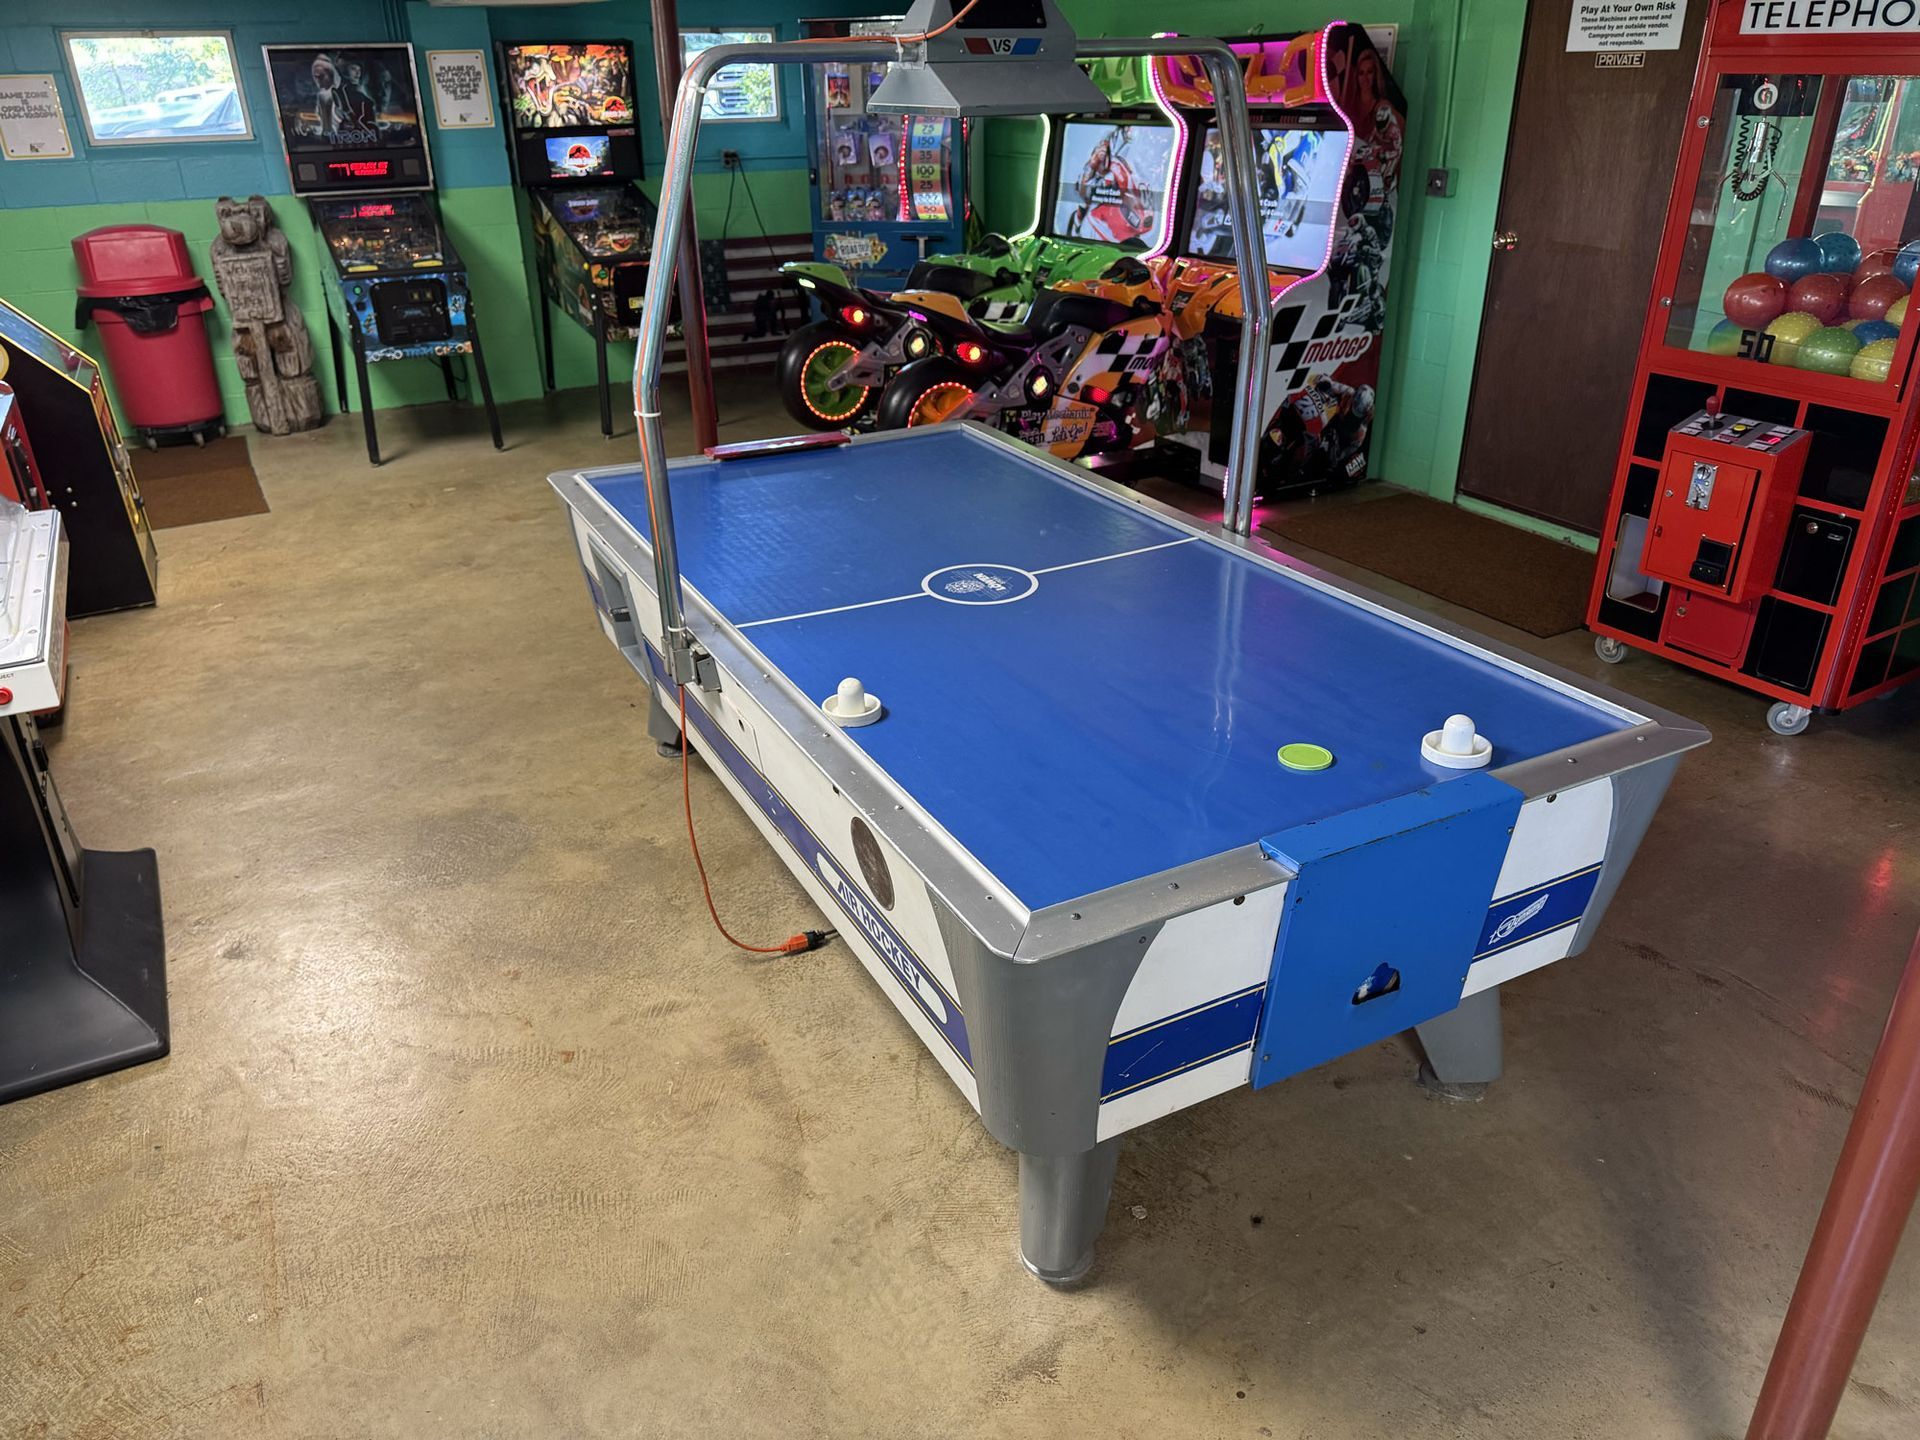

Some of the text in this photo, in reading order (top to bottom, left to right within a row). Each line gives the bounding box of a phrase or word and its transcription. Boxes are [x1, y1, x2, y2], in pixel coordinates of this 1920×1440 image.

[1581, 2, 1676, 15] Play At Your Own Risk
[1750, 0, 1920, 28] TELEPHO
[993, 38, 1011, 52] VS
[1599, 54, 1641, 65] PRIVATE
[1, 105, 25, 113] OPEN
[328, 129, 378, 145] TRON
[917, 137, 935, 145] 150
[920, 151, 932, 159] 35
[917, 165, 935, 176] 100
[920, 181, 933, 189] 25
[1737, 329, 1776, 363] 50
[1021, 409, 1046, 423] Play
[837, 880, 921, 990] AIR HOCKEY
